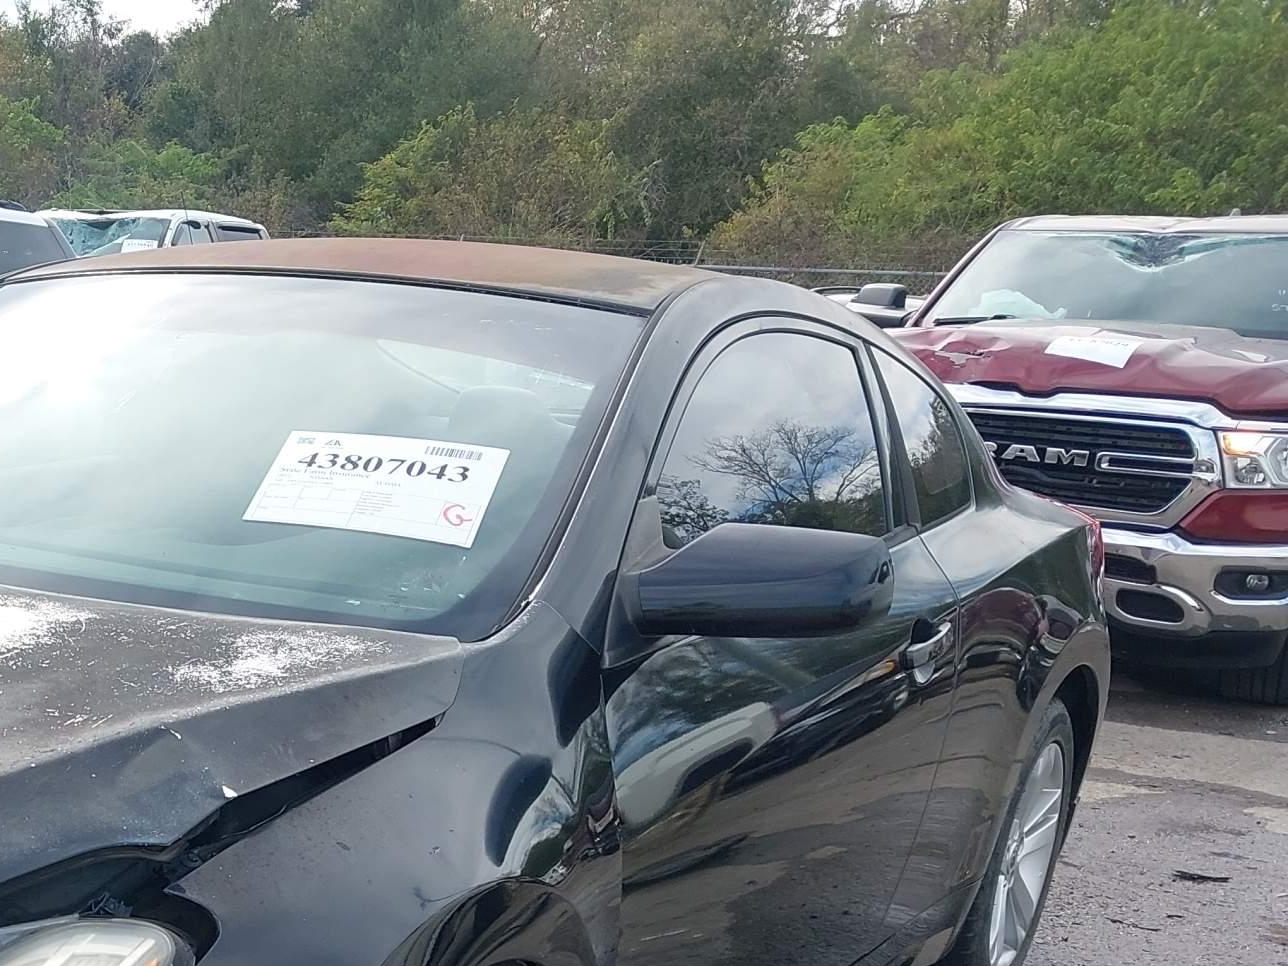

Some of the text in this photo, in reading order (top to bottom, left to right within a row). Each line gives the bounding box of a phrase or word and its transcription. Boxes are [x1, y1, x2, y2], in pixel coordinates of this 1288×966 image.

[983, 441, 1090, 467] RAM
[297, 452, 470, 483] 43807043
[443, 503, 473, 527] G
